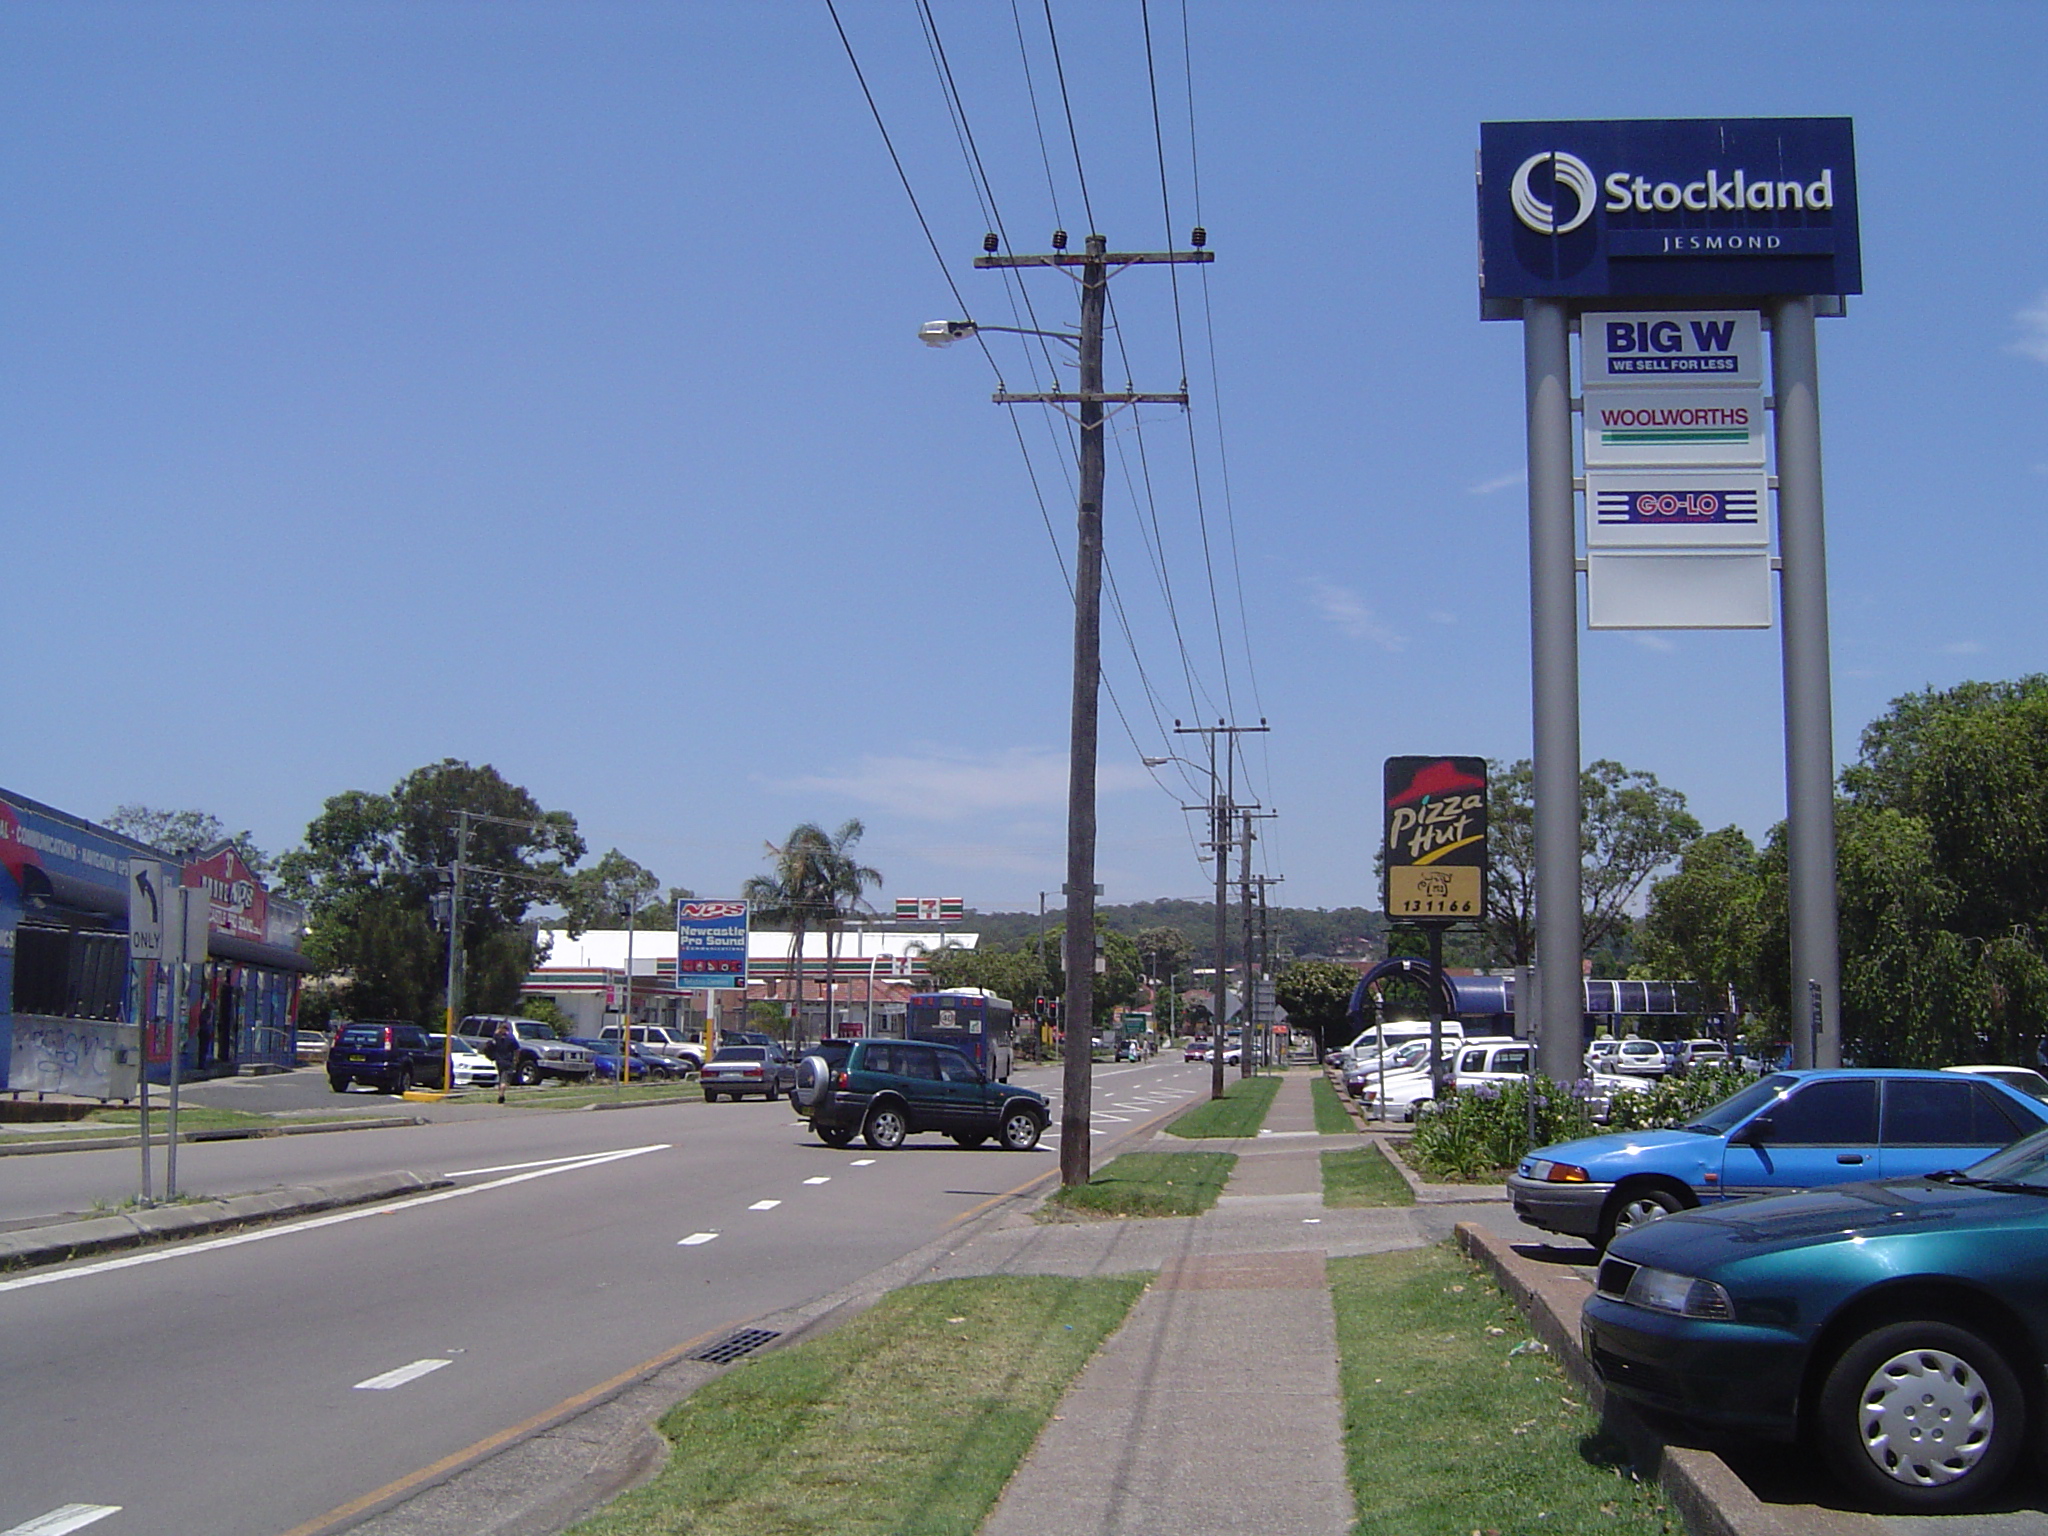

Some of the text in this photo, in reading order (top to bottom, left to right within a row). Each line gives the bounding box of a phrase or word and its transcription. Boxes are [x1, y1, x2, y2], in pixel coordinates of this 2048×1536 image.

[1605, 168, 1834, 211] Stockland
[1662, 235, 1782, 252] JESMOND
[1606, 320, 1735, 353] BIG W
[1613, 358, 1734, 372] WE SELL FOR LESS
[1601, 408, 1748, 426] WOOLWORTHS
[1636, 494, 1718, 516] GO-LO
[1390, 794, 1484, 850] Pizza
[1407, 813, 1474, 858] Hut
[681, 902, 746, 918] NPS
[680, 925, 746, 936] Newcastle
[132, 931, 161, 950] ONLY
[680, 935, 745, 946] Pro Sound
